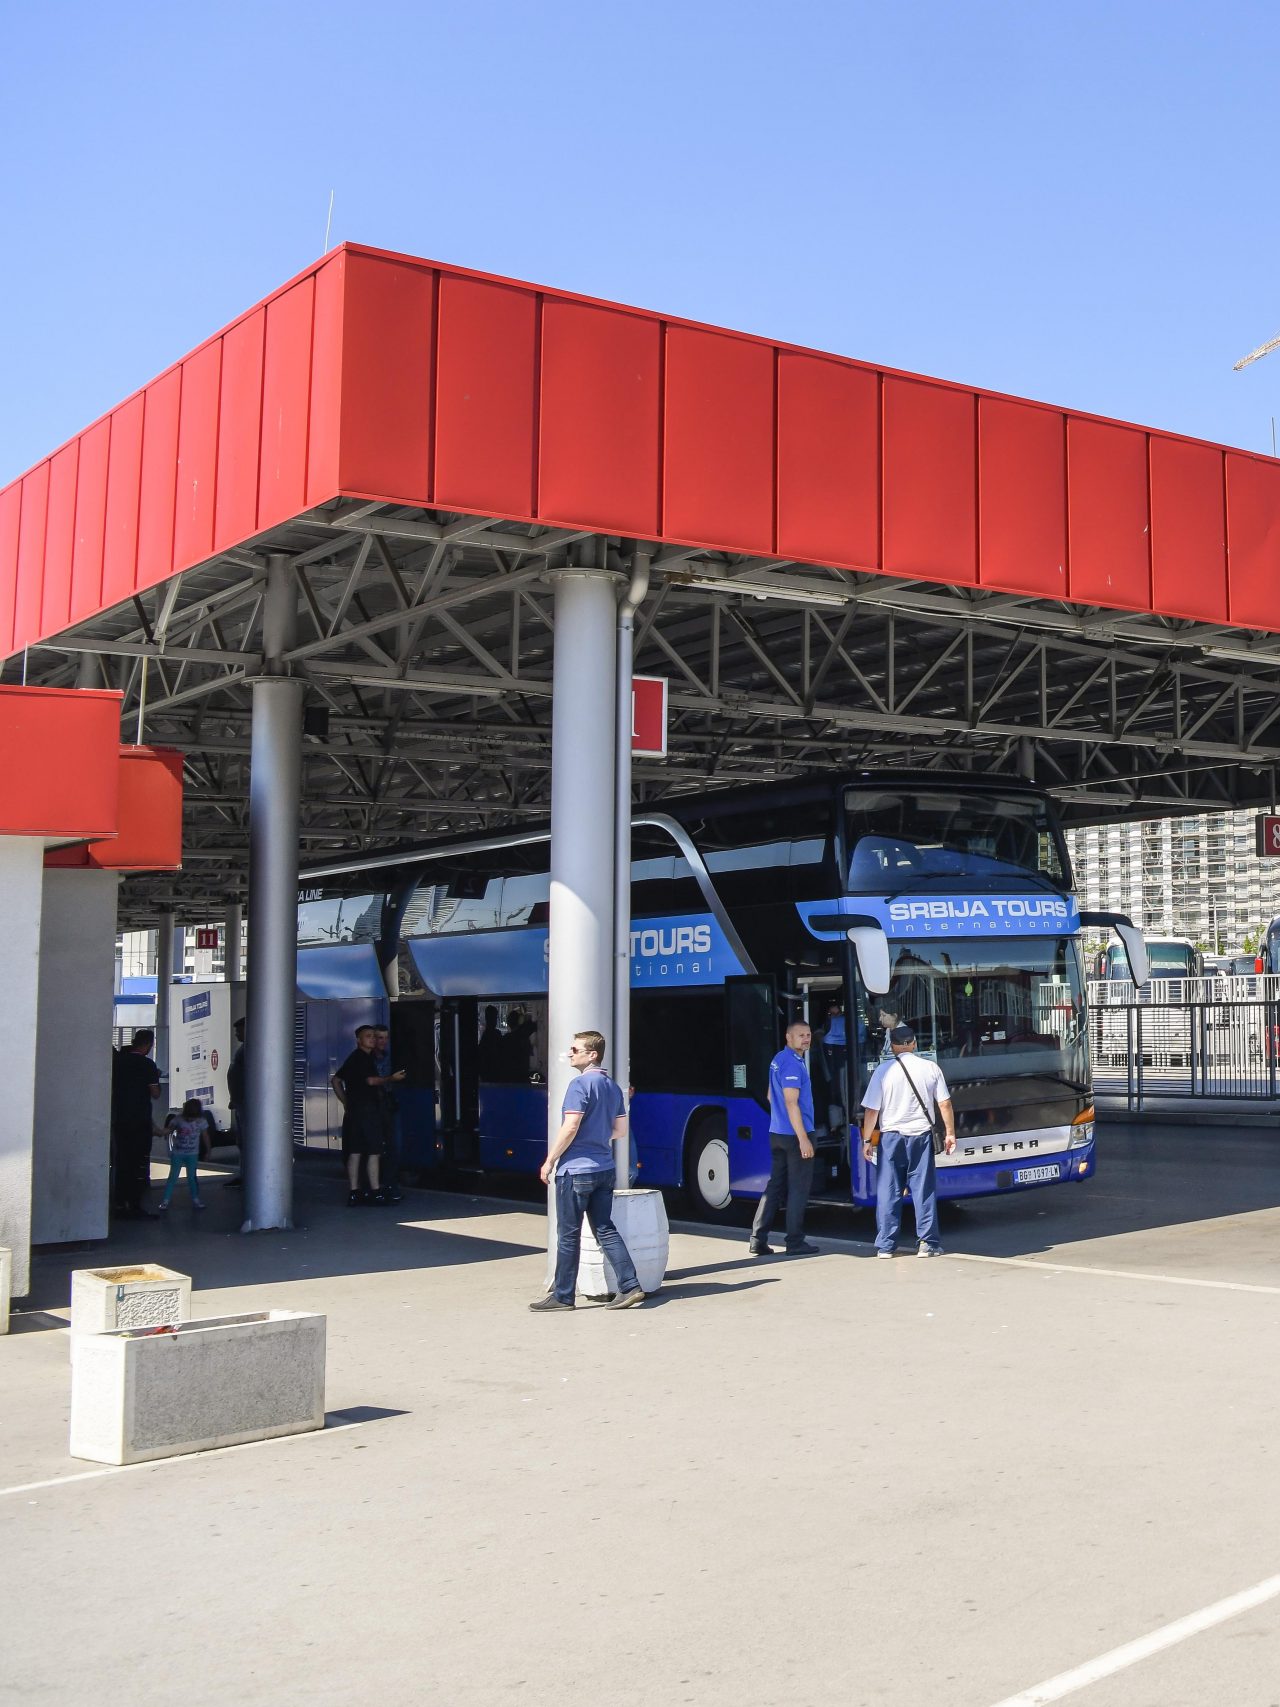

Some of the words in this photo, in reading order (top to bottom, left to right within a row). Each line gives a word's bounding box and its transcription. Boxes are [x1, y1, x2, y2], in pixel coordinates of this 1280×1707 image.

[305, 888, 323, 900] LINE
[889, 901, 989, 920] SRBIJA
[992, 901, 1067, 917] TOURS
[892, 919, 1070, 932] International
[201, 934, 214, 945] 11
[630, 925, 711, 957] TOURS
[964, 1140, 1039, 1156] SETRA
[1019, 1171, 1028, 1181] BG
